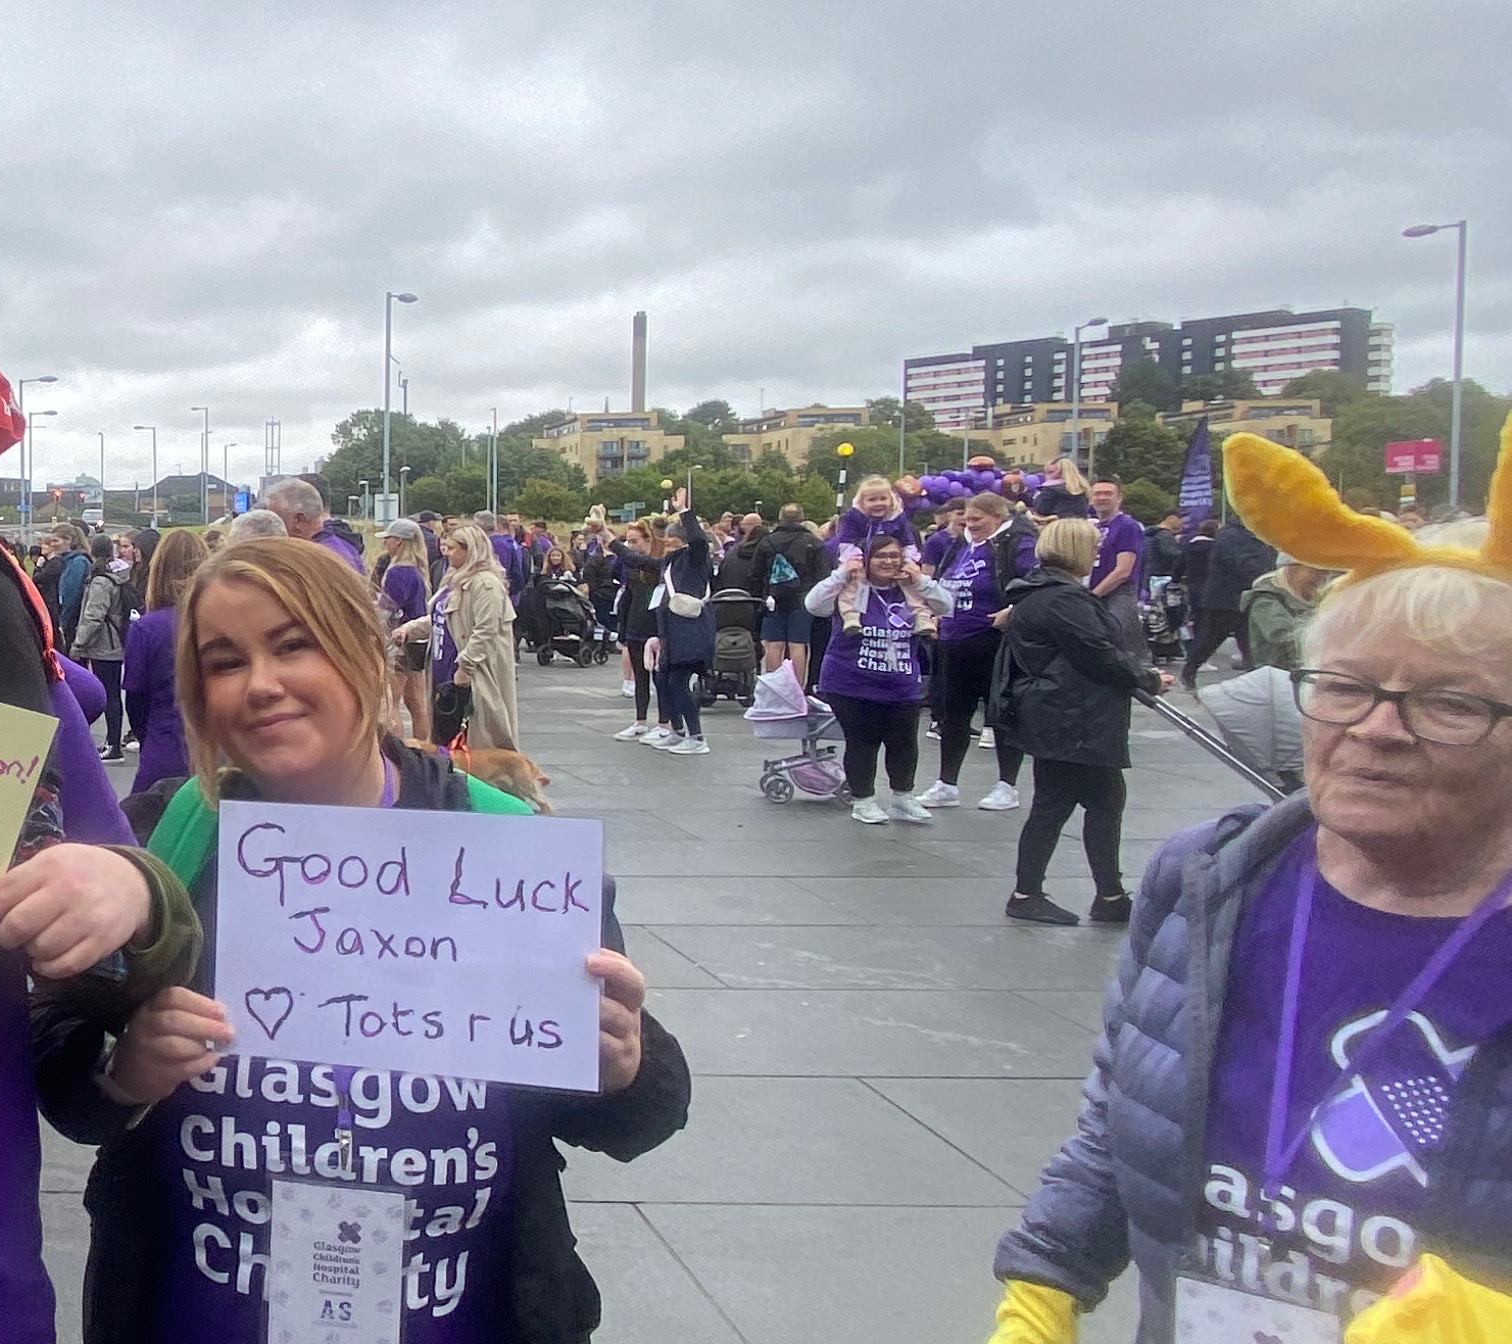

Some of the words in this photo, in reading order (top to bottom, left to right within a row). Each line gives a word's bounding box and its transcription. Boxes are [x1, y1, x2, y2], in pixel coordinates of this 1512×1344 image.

[238, 822, 410, 907] Good
[449, 846, 590, 915] Luck
[288, 906, 457, 962] Jaxon
[318, 993, 444, 1040] Tots
[469, 1013, 491, 1043] r
[509, 1005, 563, 1050] us
[180, 1114, 499, 1186] Children's
[182, 1168, 492, 1241] Hotal
[192, 1222, 469, 1318] Chty
[313, 1241, 361, 1255] Glasgow
[313, 1262, 360, 1275] Hospital
[312, 1272, 360, 1289] Charity
